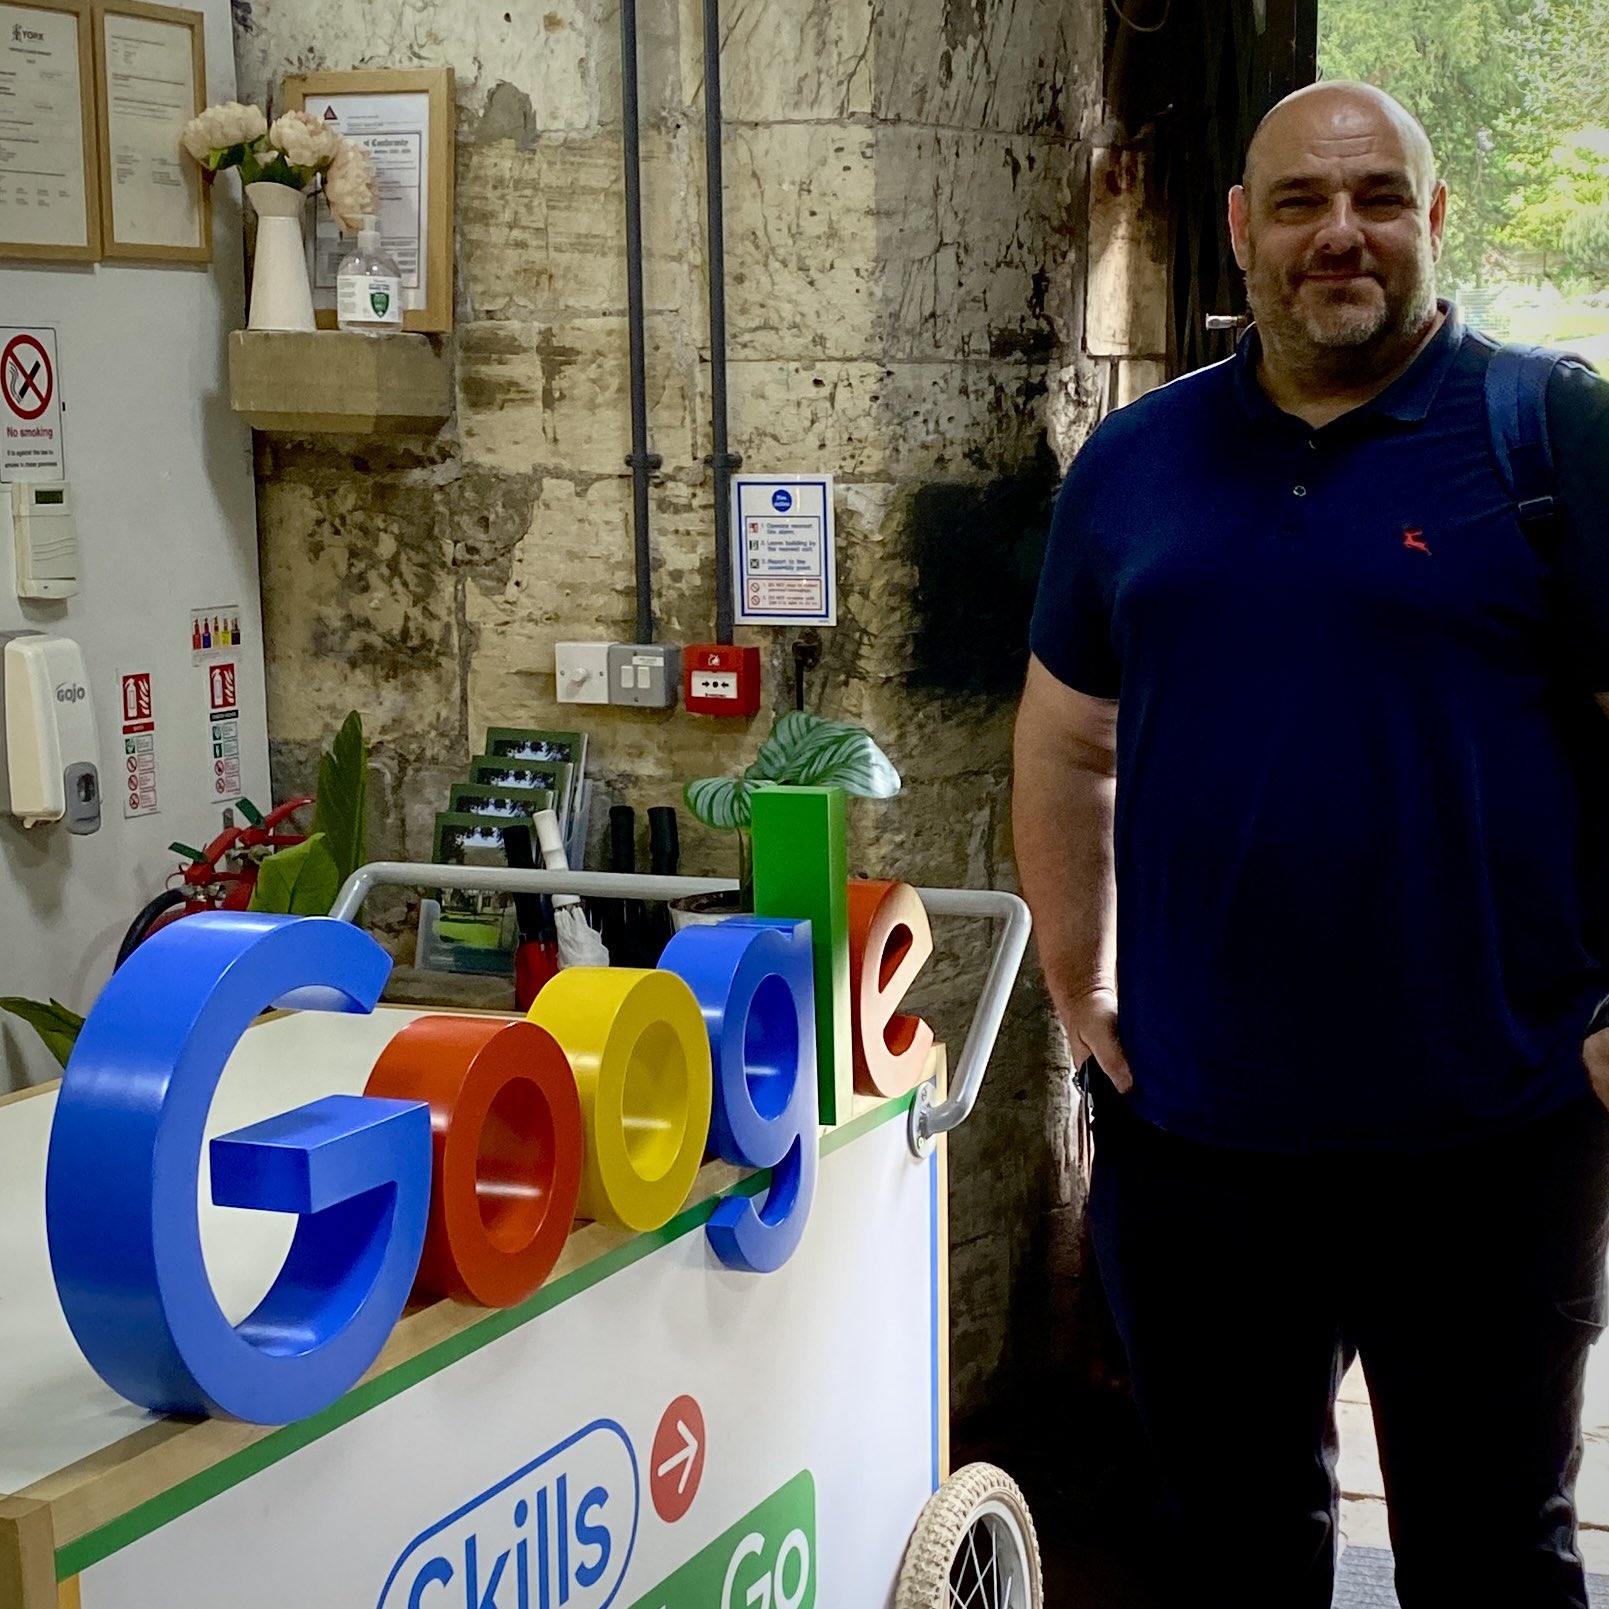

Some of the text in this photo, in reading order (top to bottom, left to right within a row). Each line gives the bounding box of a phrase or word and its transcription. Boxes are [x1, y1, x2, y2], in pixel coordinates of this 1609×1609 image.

[6, 426, 53, 440] No smoking
[46, 785, 934, 1425] Google
